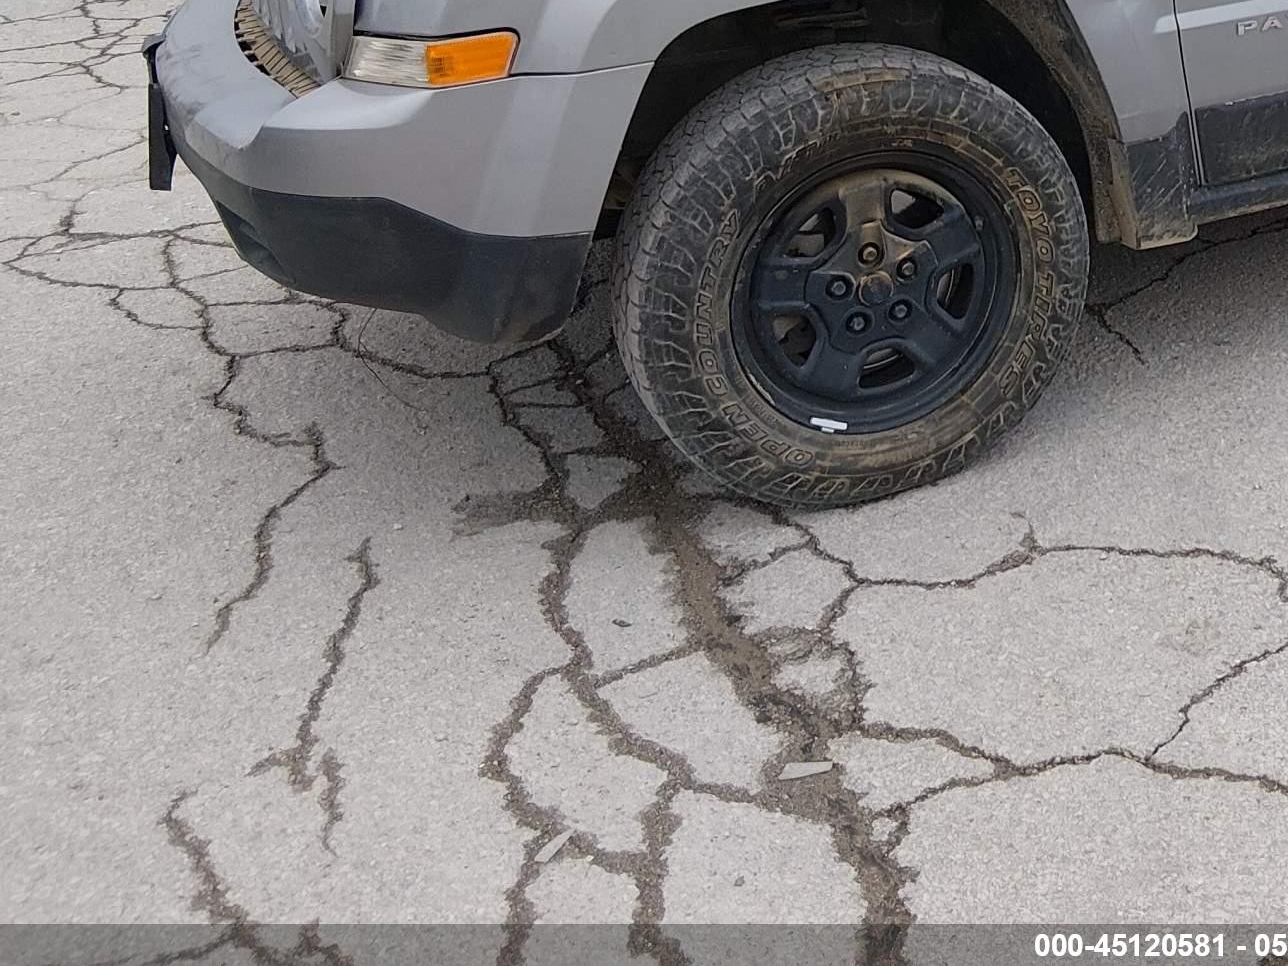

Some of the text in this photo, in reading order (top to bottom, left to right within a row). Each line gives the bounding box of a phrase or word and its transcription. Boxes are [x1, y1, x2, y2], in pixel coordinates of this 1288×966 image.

[693, 208, 740, 397] COUNTRY
[1000, 168, 1056, 397] TOYO TIRES
[720, 401, 814, 467] OPEN
